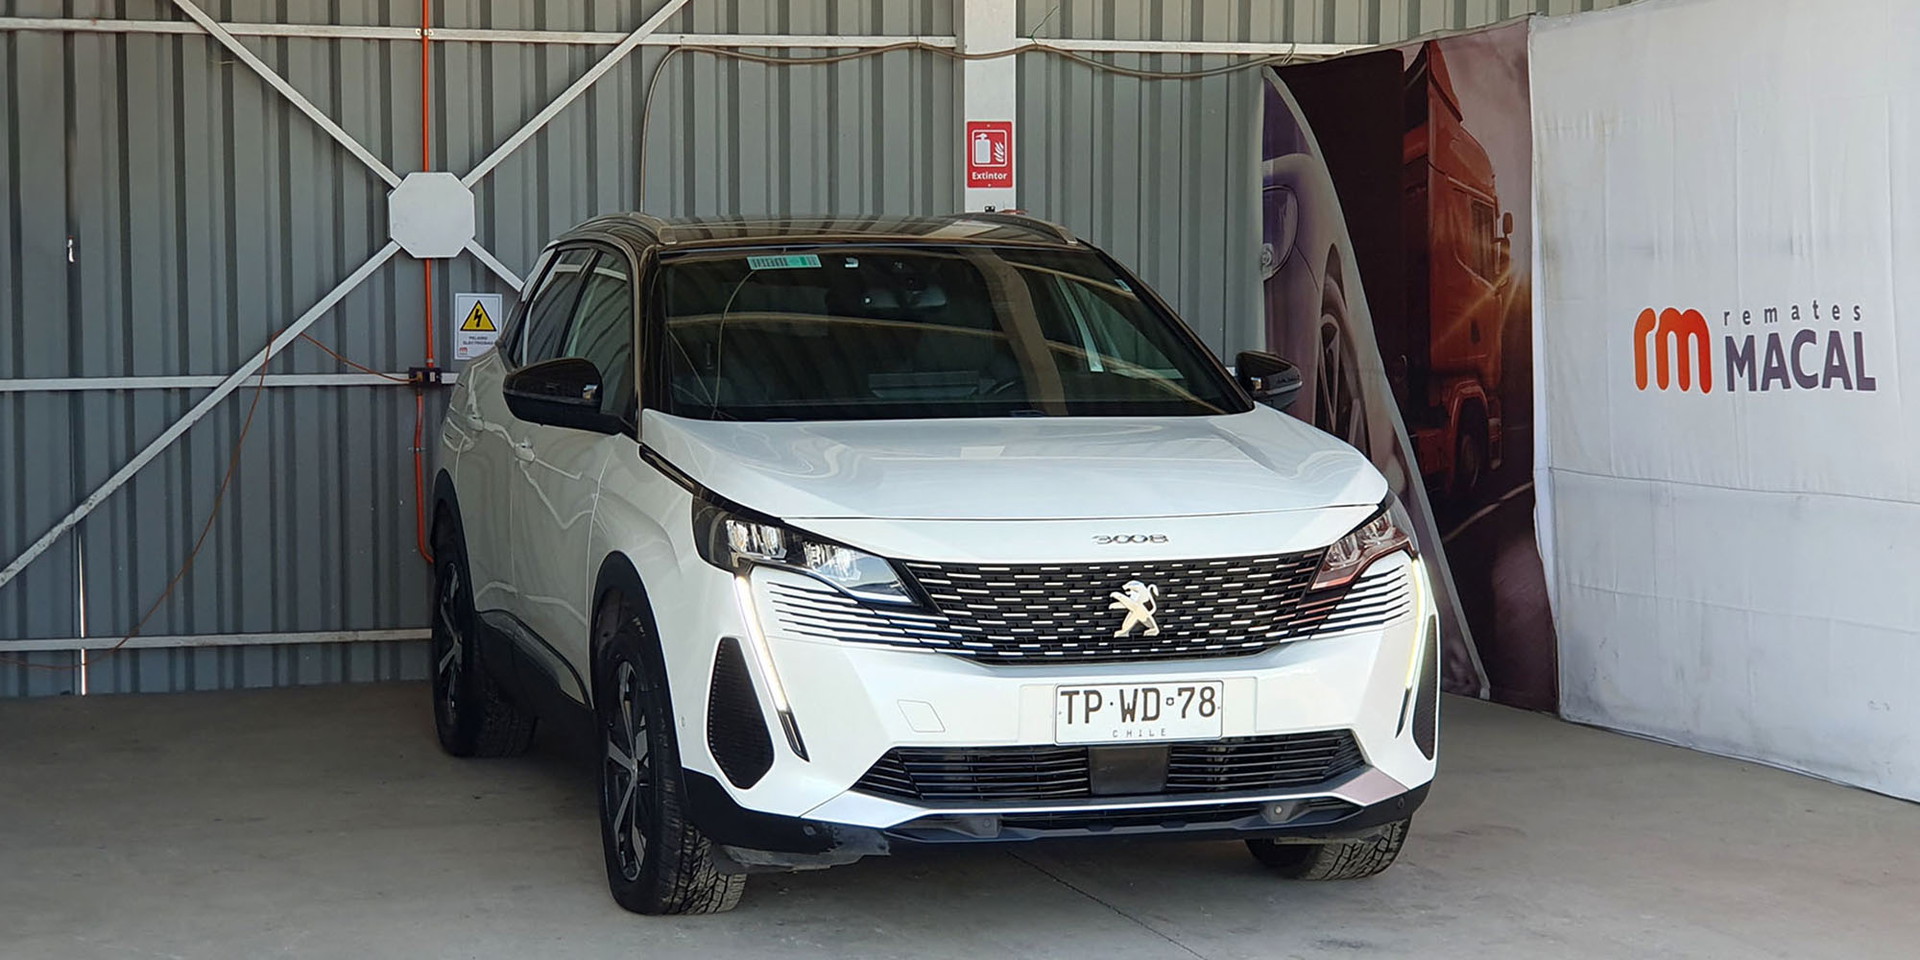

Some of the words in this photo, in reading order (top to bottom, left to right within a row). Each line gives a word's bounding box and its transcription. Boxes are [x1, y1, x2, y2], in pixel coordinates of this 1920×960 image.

[972, 172, 1007, 180] Extintor
[1723, 300, 1861, 326] remates
[1725, 329, 1877, 392] MACAL
[1092, 534, 1169, 545] 3008
[1112, 728, 1167, 738] CHILE
